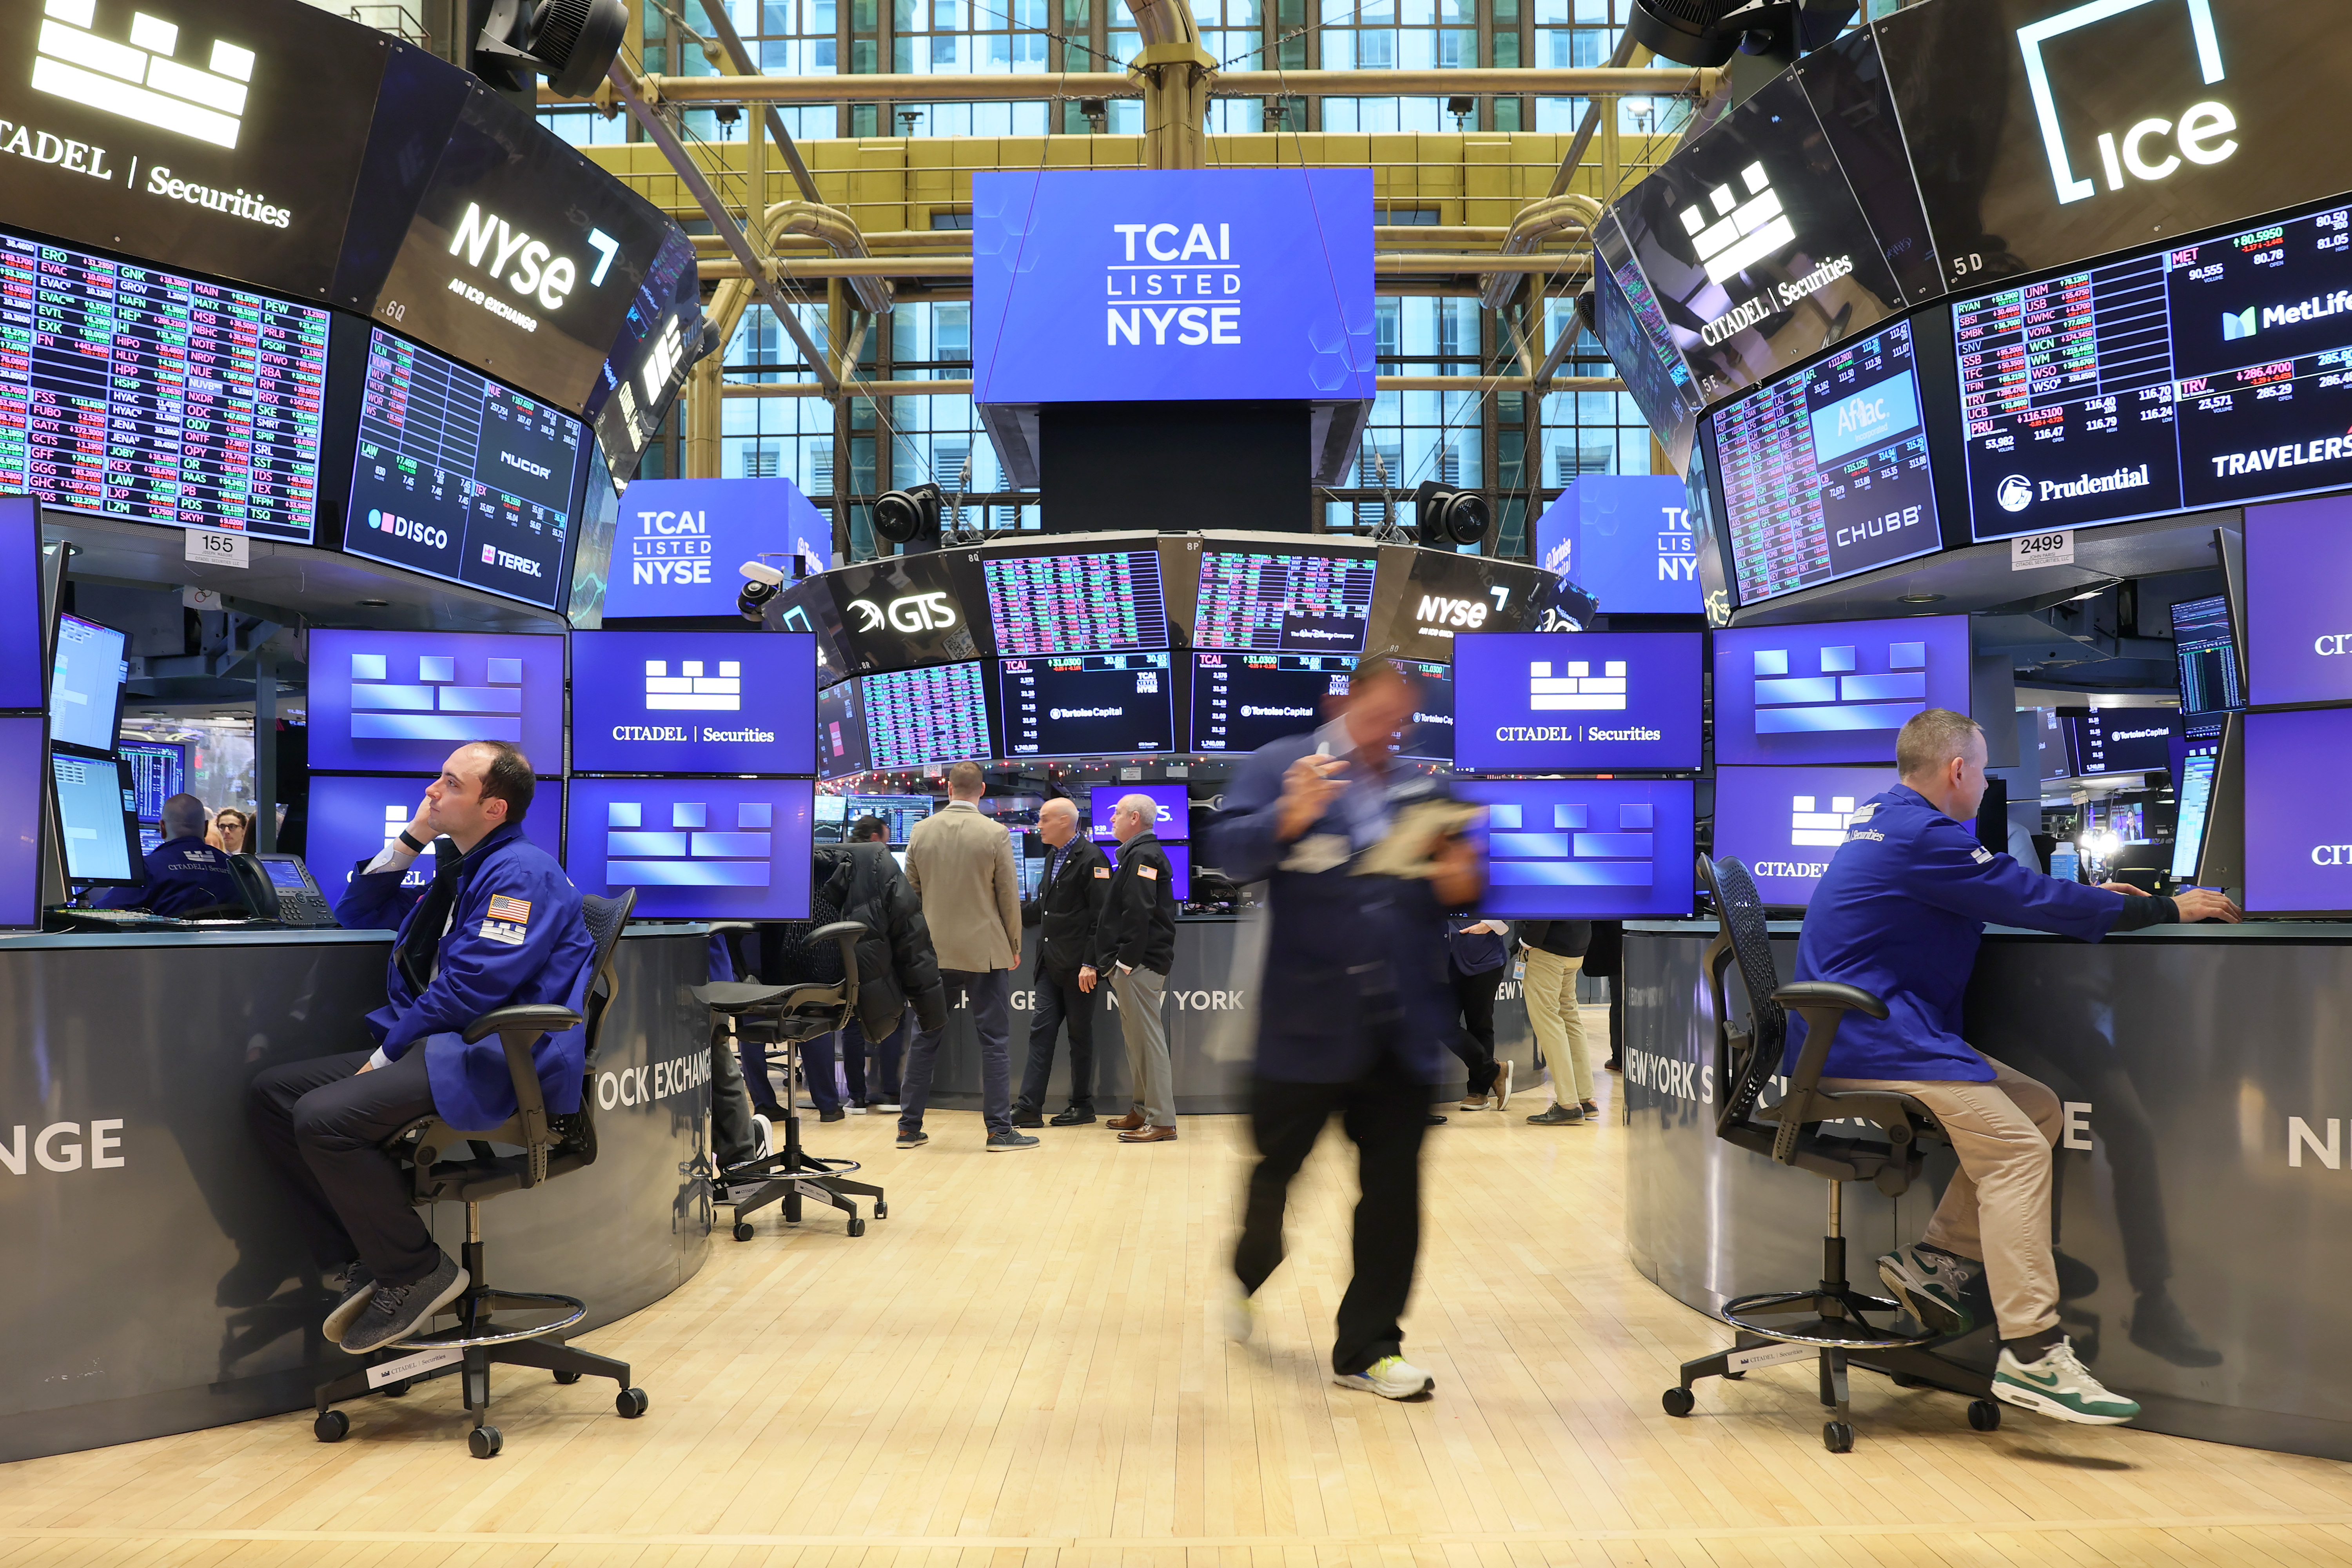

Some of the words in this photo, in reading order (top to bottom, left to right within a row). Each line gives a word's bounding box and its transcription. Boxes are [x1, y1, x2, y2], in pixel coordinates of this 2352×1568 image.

[147, 166, 291, 229] Securities
[2316, 211, 2348, 227] 80.50
[1114, 223, 1229, 261] TCAI
[2241, 227, 2283, 246] 80.5950
[2317, 233, 2348, 249] 81.05
[42, 248, 67, 263] ERO
[2172, 248, 2199, 265] MET
[2254, 249, 2283, 265] 80.78
[41, 262, 67, 276] EVAC
[121, 267, 146, 281] GNK
[2189, 263, 2223, 280] 90,555
[1107, 274, 1240, 296] LISTED
[2204, 275, 2224, 283] VOLUME
[86, 287, 113, 298] 10.1200
[120, 281, 147, 294] GROV
[196, 284, 219, 297] MAIN
[448, 278, 467, 295] AN
[2025, 284, 2048, 298] UNM
[119, 295, 146, 308] HAFN
[195, 298, 219, 311] MATX
[265, 300, 289, 314] PEW
[1701, 296, 1770, 347] CITADEL
[1778, 254, 1853, 307] Securities
[1958, 301, 1980, 313] RYAN
[2026, 299, 2047, 312] USB
[39, 305, 64, 319] EVTL
[386, 300, 405, 323] 6Q
[2027, 310, 2056, 324] UWMC
[38, 319, 62, 334] EXK
[265, 314, 277, 325] PL
[1107, 307, 1241, 345] NYSE
[1890, 325, 1908, 339] 112.42
[1961, 327, 1984, 339] SMBK
[2028, 325, 2052, 338] VOYA
[38, 334, 54, 347] FN
[1962, 341, 1982, 354] SNV
[2029, 338, 2054, 352] WCN
[374, 344, 387, 357] VLN
[1806, 368, 1817, 381] AFL
[2244, 361, 2291, 380] 286.4700
[2181, 378, 2208, 393] TRV
[2256, 383, 2292, 399] 285.29
[34, 391, 56, 404] FSS
[114, 391, 139, 404] HYAC
[2198, 395, 2233, 410] 23,571
[33, 405, 61, 418] FUBO
[2023, 407, 2063, 423] 116.5100
[2140, 406, 2172, 421] 116.24
[33, 419, 60, 432] GATX
[257, 418, 279, 429] SMRT
[1778, 417, 1790, 428] LMND
[1971, 420, 1993, 434] PRU
[2086, 417, 2117, 431] 116.79
[1855, 423, 1888, 442] Incorporated
[2034, 426, 2064, 441] 116.47
[361, 442, 379, 456] LAW
[1985, 436, 2014, 450] 53,982
[110, 446, 135, 458] JOBY
[501, 451, 550, 479] NUCOR
[2039, 464, 2150, 501] Prudential
[475, 484, 487, 496] TEX
[107, 501, 130, 513] LZM
[180, 512, 203, 523] SKYH
[251, 509, 270, 520] TSQ
[637, 511, 705, 534] TCAI
[1837, 506, 1919, 546] CHUBB
[395, 517, 447, 549] DISCO
[202, 535, 233, 552] 155
[633, 541, 711, 555] LISTED
[1187, 542, 1200, 550] 8P
[2021, 535, 2063, 554] 2499
[497, 550, 541, 577] TEREX
[968, 554, 980, 562] 8Q
[633, 561, 711, 584] NYSE
[1739, 570, 1750, 579] BOW
[1799, 563, 1809, 572] RKT
[888, 592, 956, 632] GTS
[1006, 660, 1027, 670] TCAI
[1053, 658, 1082, 666] 31.0300
[1104, 656, 1124, 665] 30.69
[1146, 654, 1167, 663] 30.93
[1200, 655, 1221, 664] TCAI
[1248, 655, 1277, 664] 31.0300
[1060, 709, 1093, 718] Tortoise
[1093, 707, 1122, 718] Capital
[1251, 707, 1284, 716] Tortoise
[1284, 707, 1313, 718] Capital
[1421, 713, 1443, 724] Tortoise
[613, 726, 687, 741] CITADEL
[703, 728, 774, 742] Securities
[1496, 727, 1572, 741] CITADEL
[1588, 727, 1661, 741] Securities
[2120, 730, 2145, 740] Tortoise
[2145, 727, 2169, 737] Capital
[1172, 990, 1245, 1010] YORK
[595, 1065, 650, 1111] OCK
[655, 1047, 711, 1100] EXCHANGE
[1626, 1045, 1648, 1086] NEW
[1650, 1054, 1696, 1101] YORK
[1750, 1354, 1775, 1363] CITADEL
[1780, 1349, 1803, 1357] Securities
[391, 1363, 417, 1374] CITADEL
[422, 1354, 446, 1365] Securities
